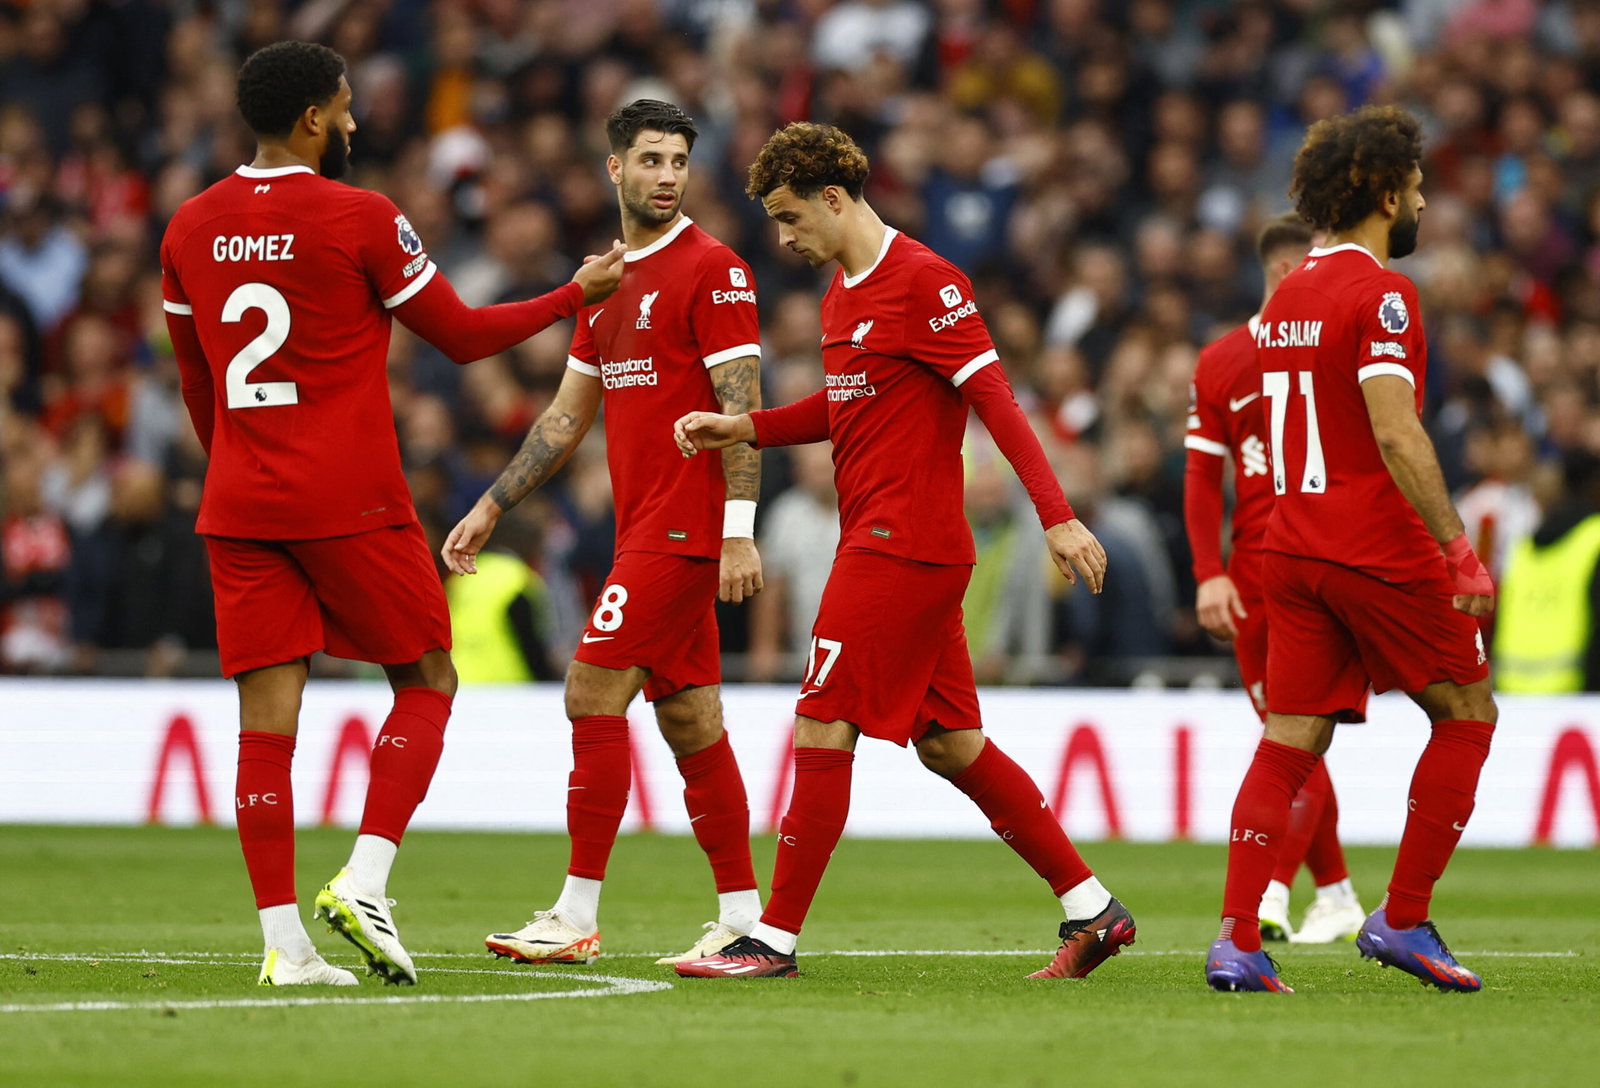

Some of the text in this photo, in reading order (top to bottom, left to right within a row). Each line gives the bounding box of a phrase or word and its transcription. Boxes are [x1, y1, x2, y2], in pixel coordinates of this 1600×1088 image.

[212, 234, 294, 262] GOMEZ
[221, 282, 299, 410] 2
[1258, 320, 1323, 348] M.SALAH
[1262, 371, 1327, 496] 11
[593, 584, 628, 632] 8
[805, 635, 842, 687] 17
[372, 735, 407, 750] FC
[236, 792, 278, 809] LFC
[1231, 828, 1269, 846] LFC
